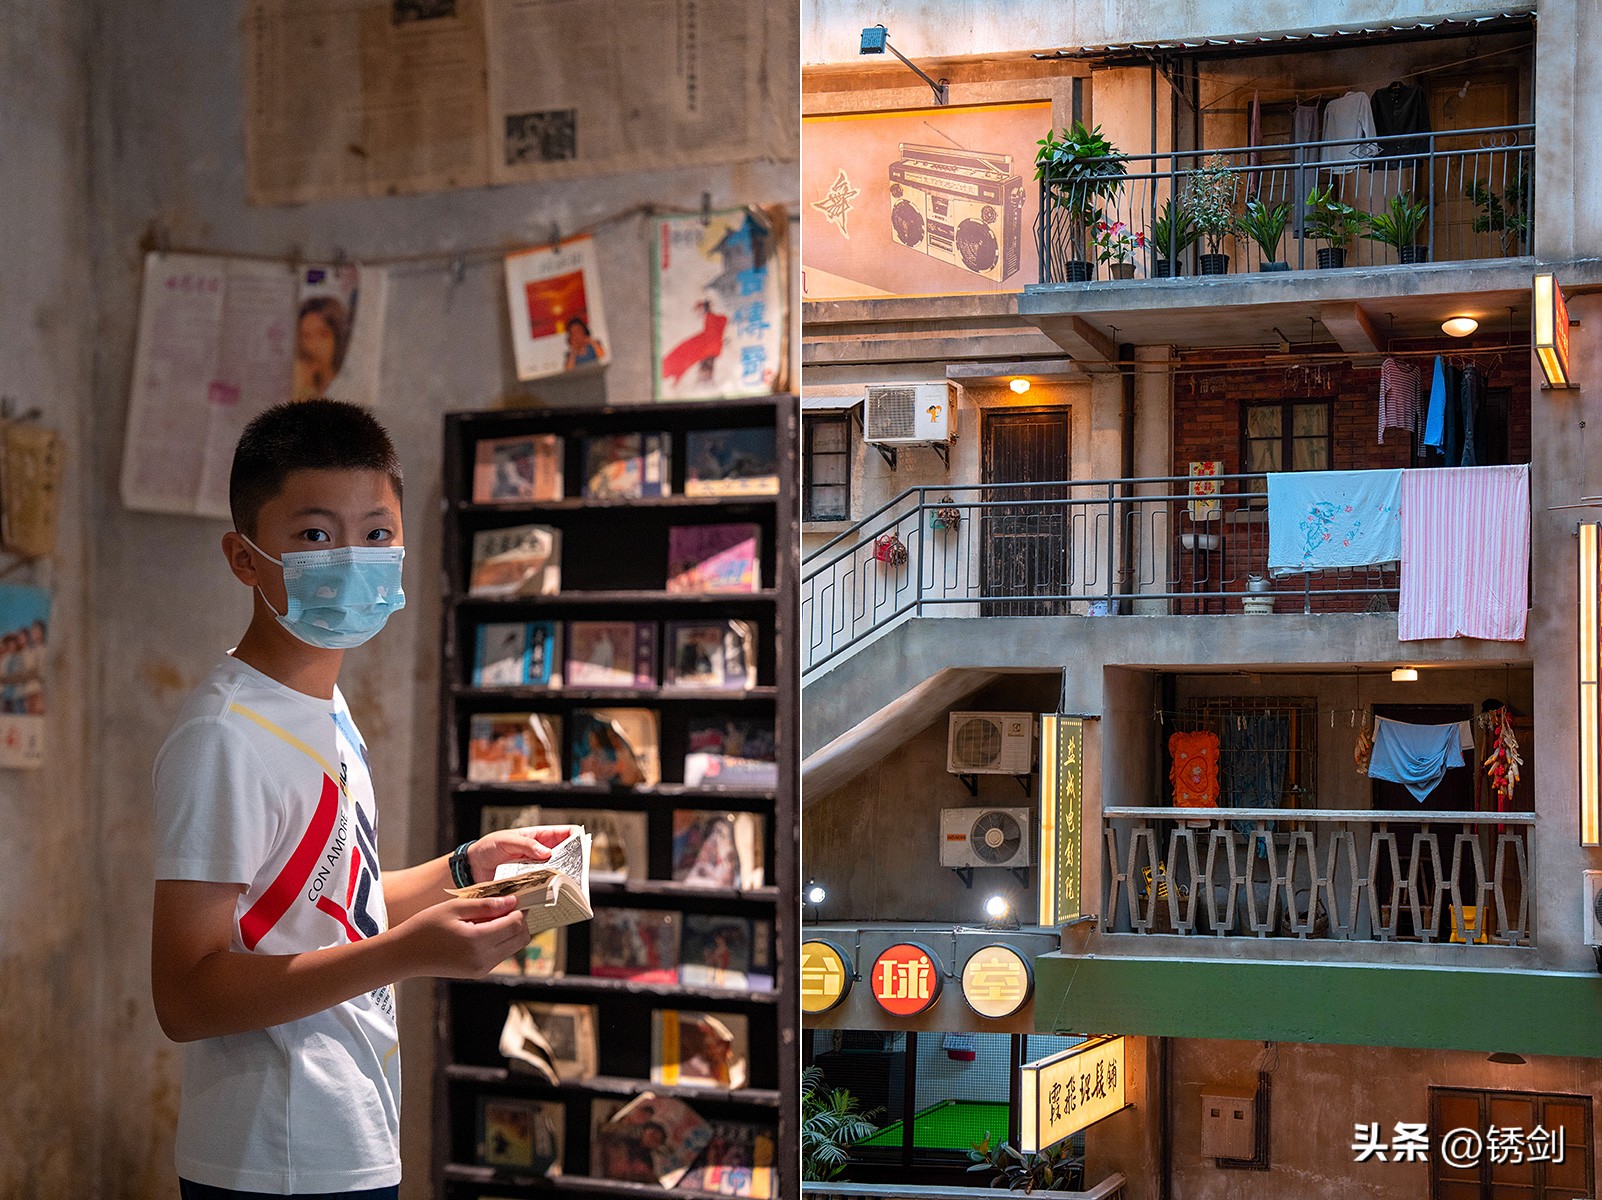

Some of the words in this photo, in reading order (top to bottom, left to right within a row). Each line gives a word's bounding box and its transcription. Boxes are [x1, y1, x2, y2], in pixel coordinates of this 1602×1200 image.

[308, 866, 331, 902] CON
[327, 809, 349, 866] AMORE
[802, 954, 1020, 1000] 台球室
